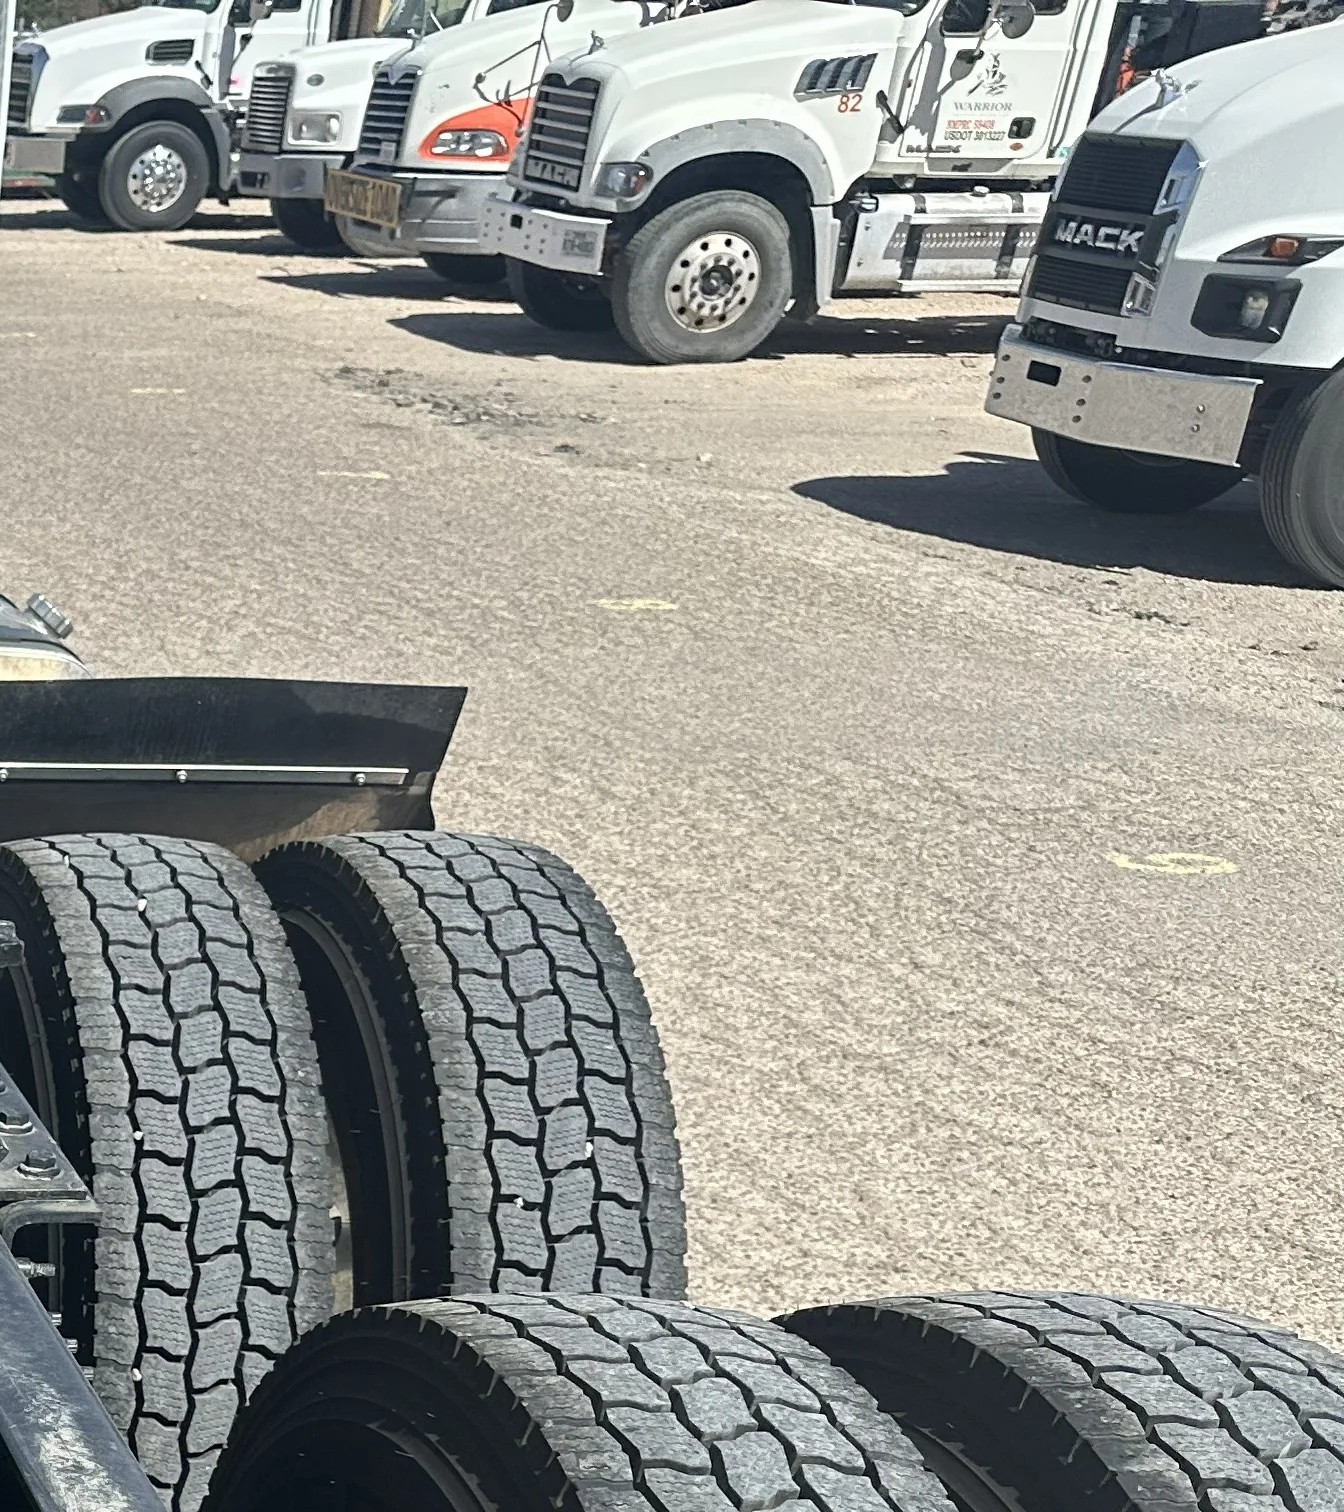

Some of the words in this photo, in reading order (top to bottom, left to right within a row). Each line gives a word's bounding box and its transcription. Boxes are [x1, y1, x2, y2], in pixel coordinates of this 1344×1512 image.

[838, 94, 862, 113] 82
[953, 101, 1013, 112] WARRIOR
[1055, 219, 1145, 252] MACK
